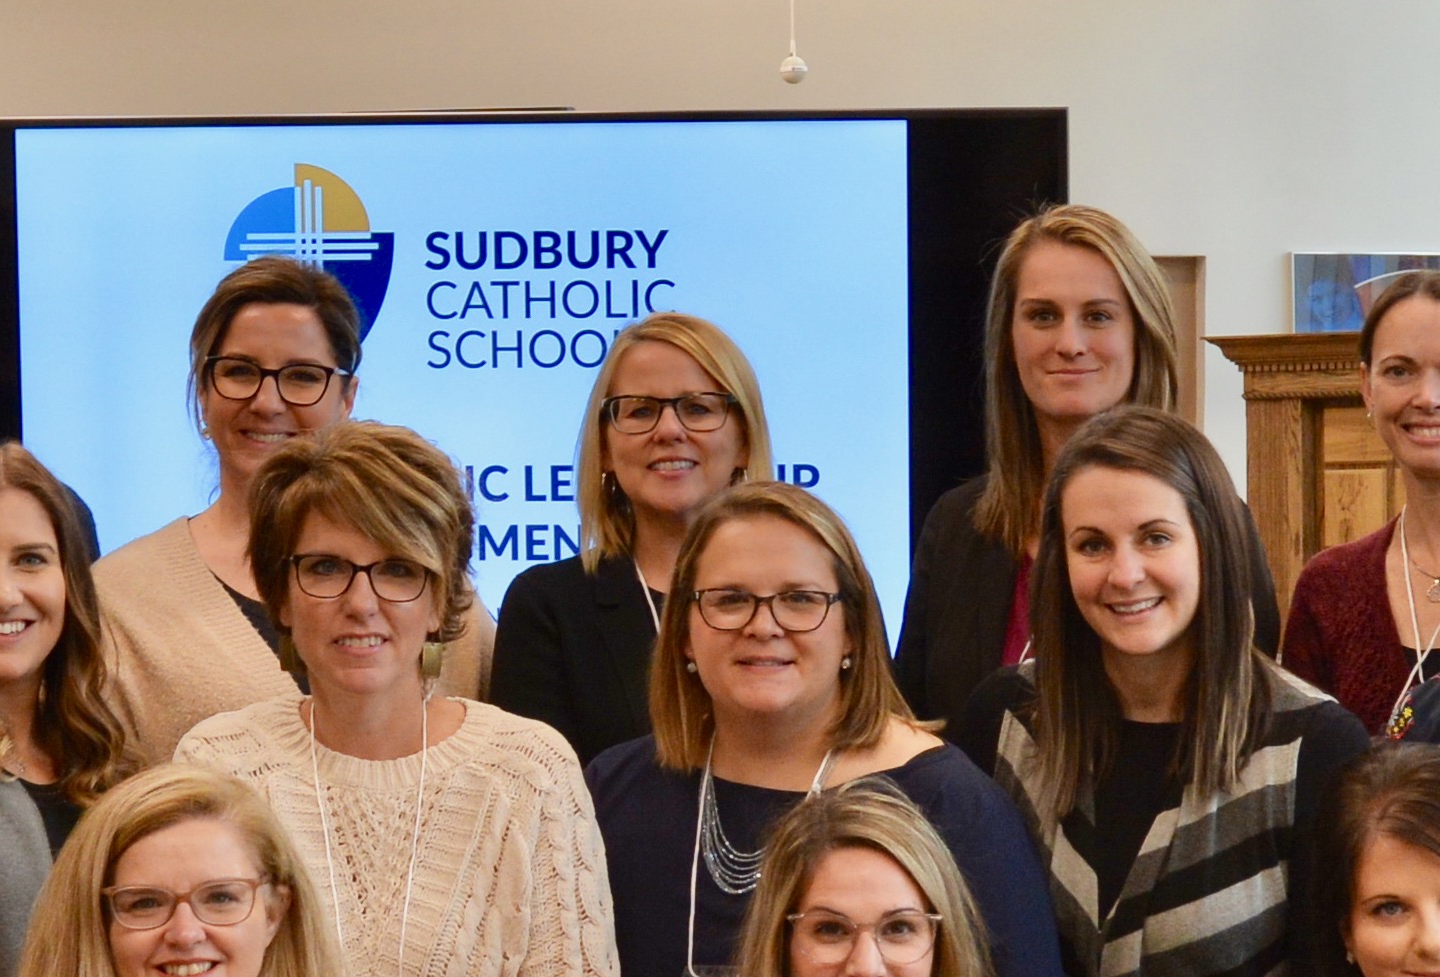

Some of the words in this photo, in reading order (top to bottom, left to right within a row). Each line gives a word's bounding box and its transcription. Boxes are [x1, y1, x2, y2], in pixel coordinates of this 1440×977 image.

[424, 229, 669, 271] SUDBURY
[426, 278, 675, 320] CATHOLIC
[427, 328, 620, 369] SCHOO
